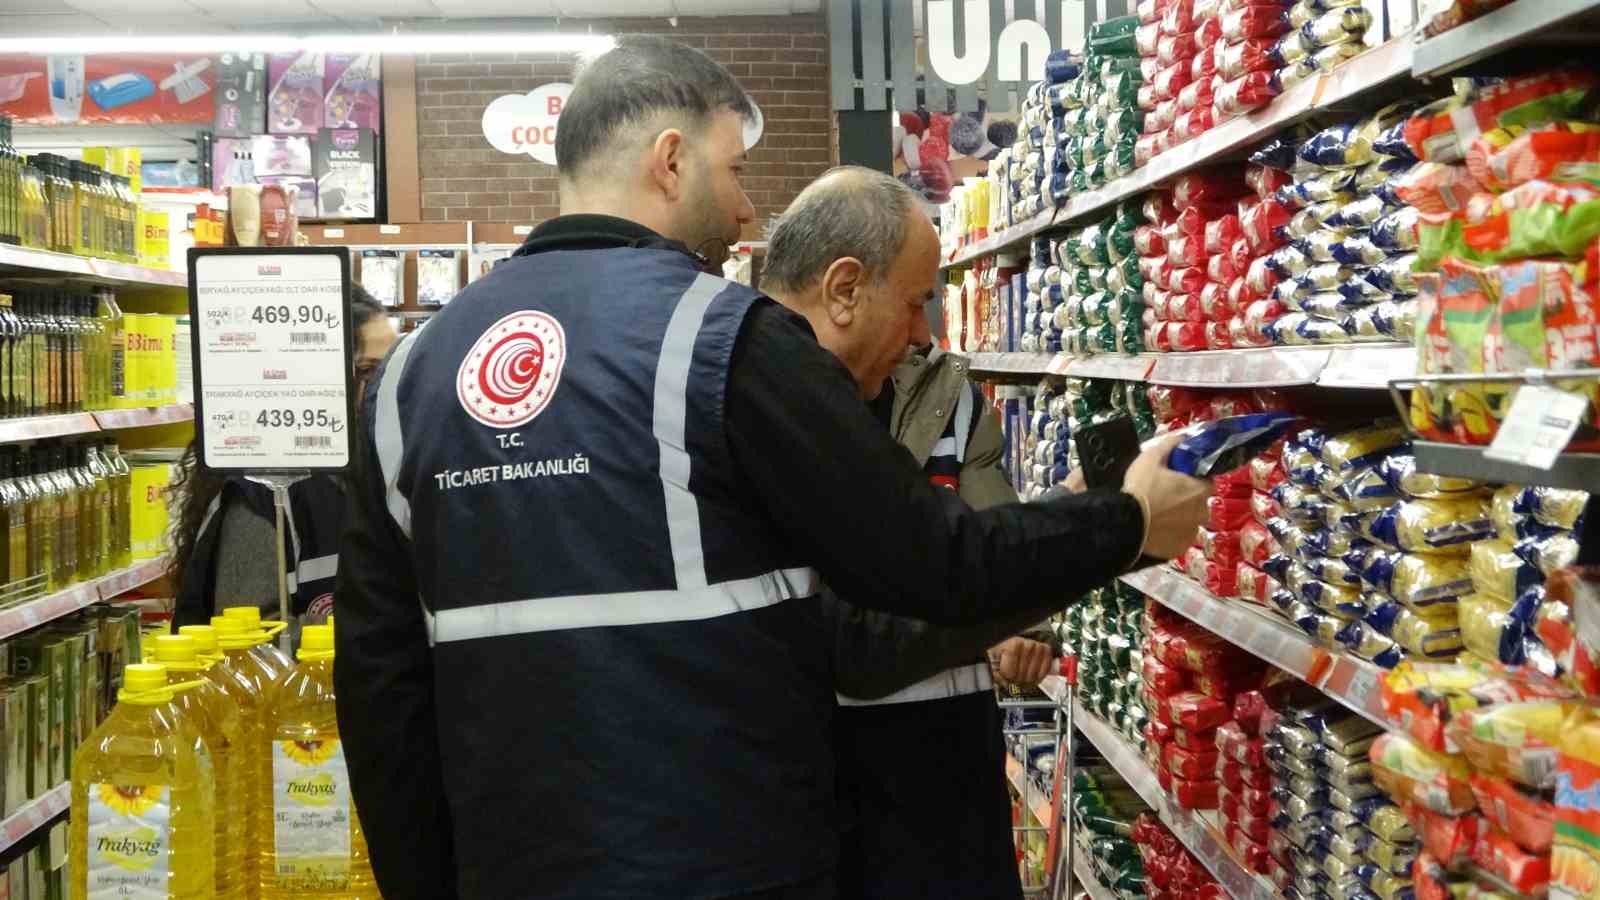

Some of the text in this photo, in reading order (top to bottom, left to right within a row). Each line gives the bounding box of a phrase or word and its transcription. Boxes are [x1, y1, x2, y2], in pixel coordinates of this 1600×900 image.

[496, 433, 524, 448] T.C.
[434, 453, 590, 490] TİCARET BAKANLIĞI
